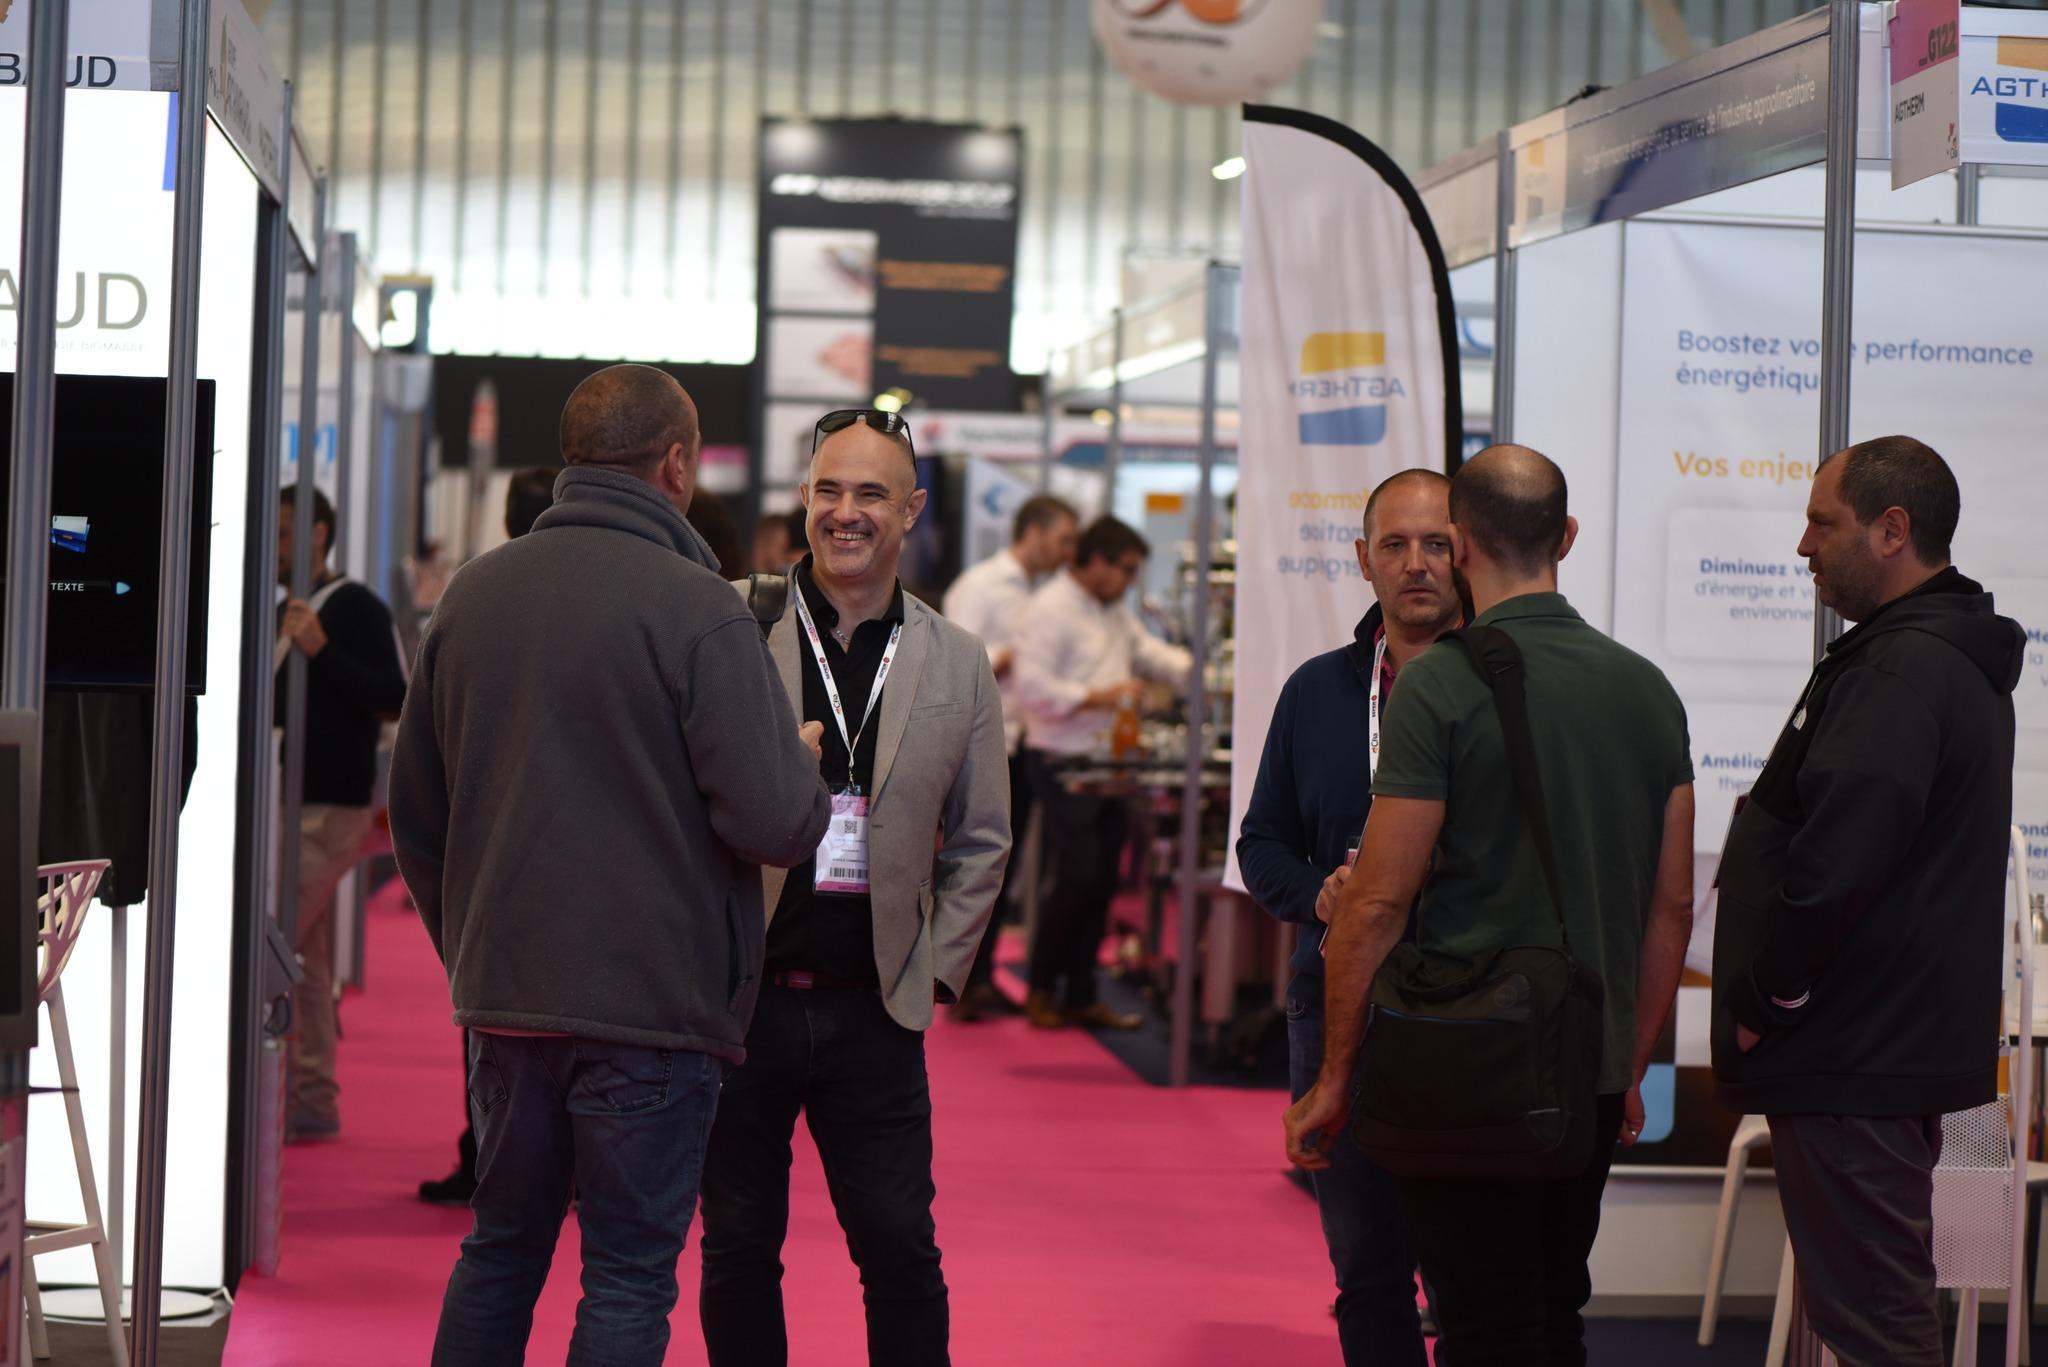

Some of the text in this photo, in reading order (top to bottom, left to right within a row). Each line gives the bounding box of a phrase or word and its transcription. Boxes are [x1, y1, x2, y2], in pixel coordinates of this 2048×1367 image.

[1928, 20, 1957, 62] G122
[0, 53, 117, 88] BUD
[1894, 92, 1925, 124] AGTHERM
[1678, 330, 1781, 356] Boostez
[1866, 338, 2034, 365] performance
[1676, 361, 1821, 394] énergétiqu
[1673, 450, 1729, 478] Vos
[1700, 557, 1787, 577] Diminuez
[50, 582, 84, 592] TEXTE
[1695, 580, 1774, 601] d'énergie
[1779, 585, 1796, 597] et
